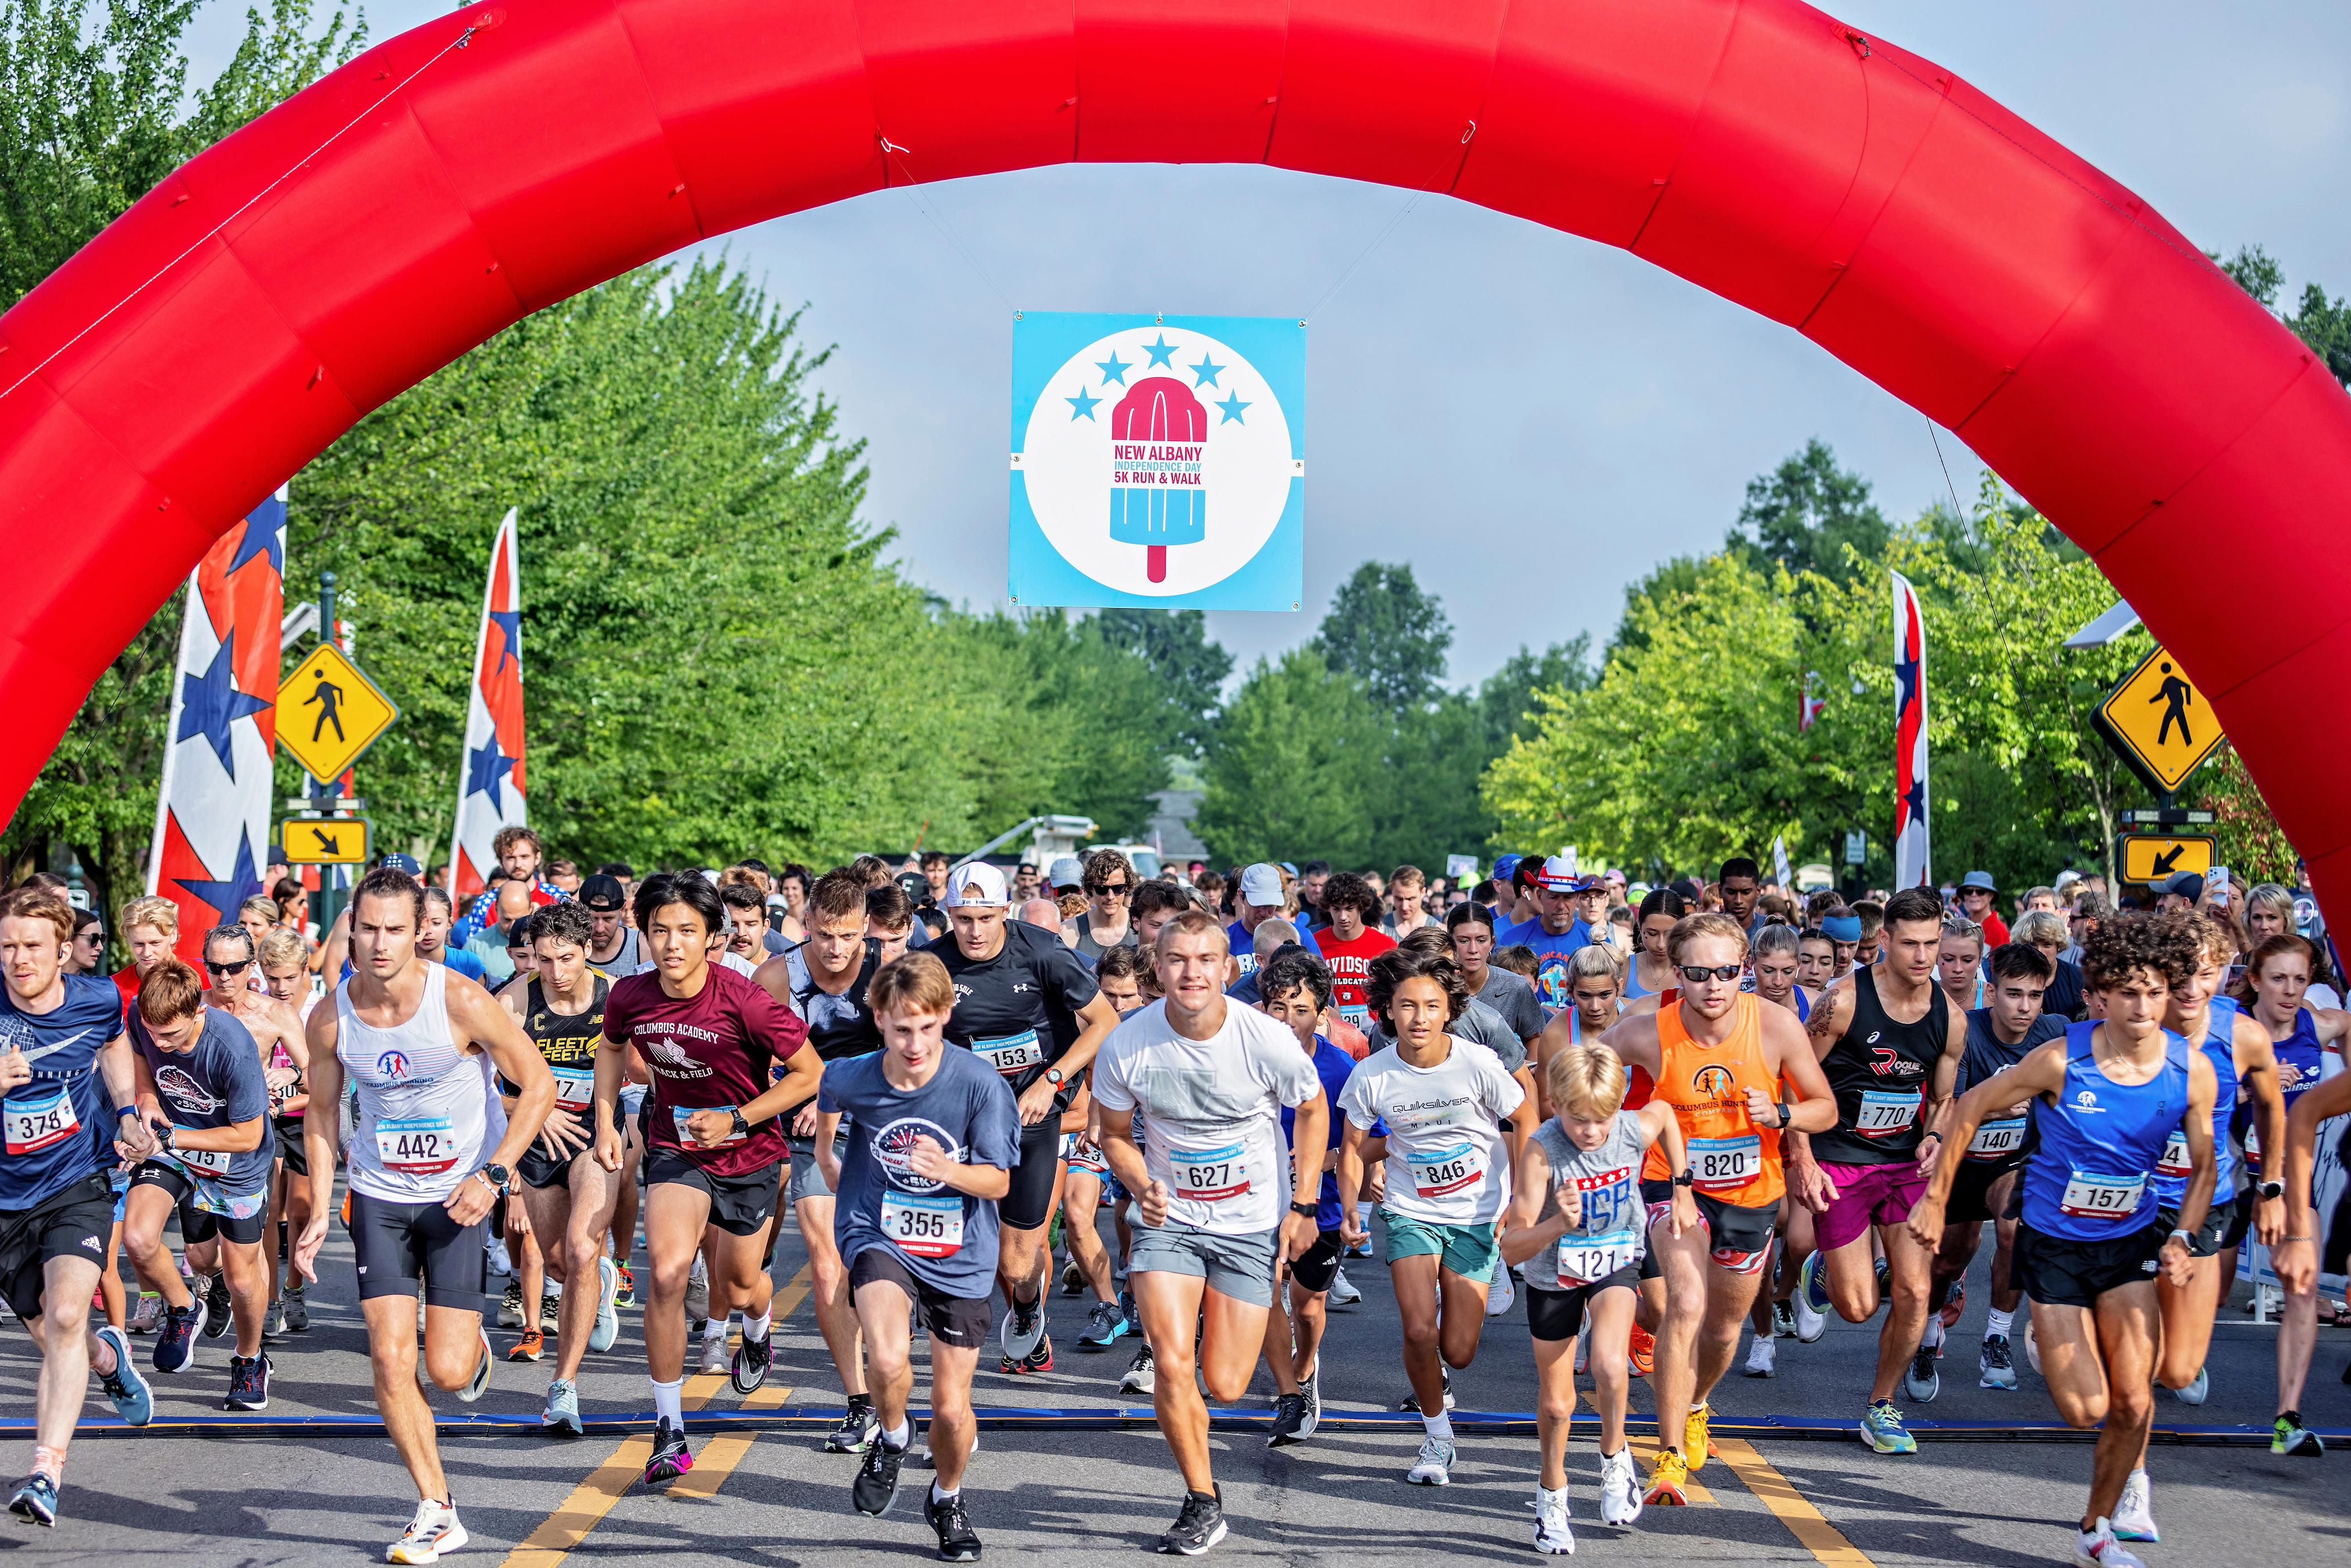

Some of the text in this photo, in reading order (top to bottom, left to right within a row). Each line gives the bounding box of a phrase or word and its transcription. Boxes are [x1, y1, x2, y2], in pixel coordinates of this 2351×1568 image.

[1114, 445, 1202, 462] NEW ALBANY
[1114, 461, 1201, 472] INDEPENDENCE DAY
[1114, 472, 1201, 485] 5K RUN & WALK
[1325, 956, 1370, 975] AVIDSO
[959, 984, 973, 996] SOLE
[534, 1014, 545, 1031] C
[634, 1022, 719, 1044] COLUMBUS ACADEMY
[537, 1037, 588, 1050] FLEET
[997, 1038, 1024, 1047] INDEPENDENCE
[542, 1048, 583, 1061] FEET
[991, 1048, 1027, 1067] 153
[648, 1063, 678, 1079] TRACK
[690, 1067, 713, 1078] FIELD
[363, 1080, 398, 1088] COLUMBUS
[183, 1100, 198, 1110] 5K
[1671, 1102, 1719, 1111] COLUMBUS
[1695, 1108, 1737, 1117] COMPANY
[1872, 1107, 1906, 1126] 770
[20, 1109, 62, 1139] 378
[397, 1134, 439, 1159] 442
[1714, 1140, 1744, 1148] INDEPENDENCE
[1981, 1131, 2011, 1149] 140
[872, 1148, 880, 1159] 20
[1196, 1151, 1227, 1161] INDEPENDENCE
[1431, 1151, 1459, 1161] INDEPENDENCE
[882, 1155, 905, 1166] new
[1704, 1152, 1744, 1177] 820
[889, 1167, 919, 1176] INDEPEND
[1189, 1163, 1229, 1187] 627
[1426, 1160, 1465, 1184] 846
[910, 1176, 931, 1187] 5K
[2087, 1188, 2129, 1208] 157
[900, 1211, 944, 1237] 355
[81, 1240, 102, 1253] adidas
[1589, 1236, 1618, 1245] INDEPENDENCE
[1578, 1250, 1615, 1277] 121
